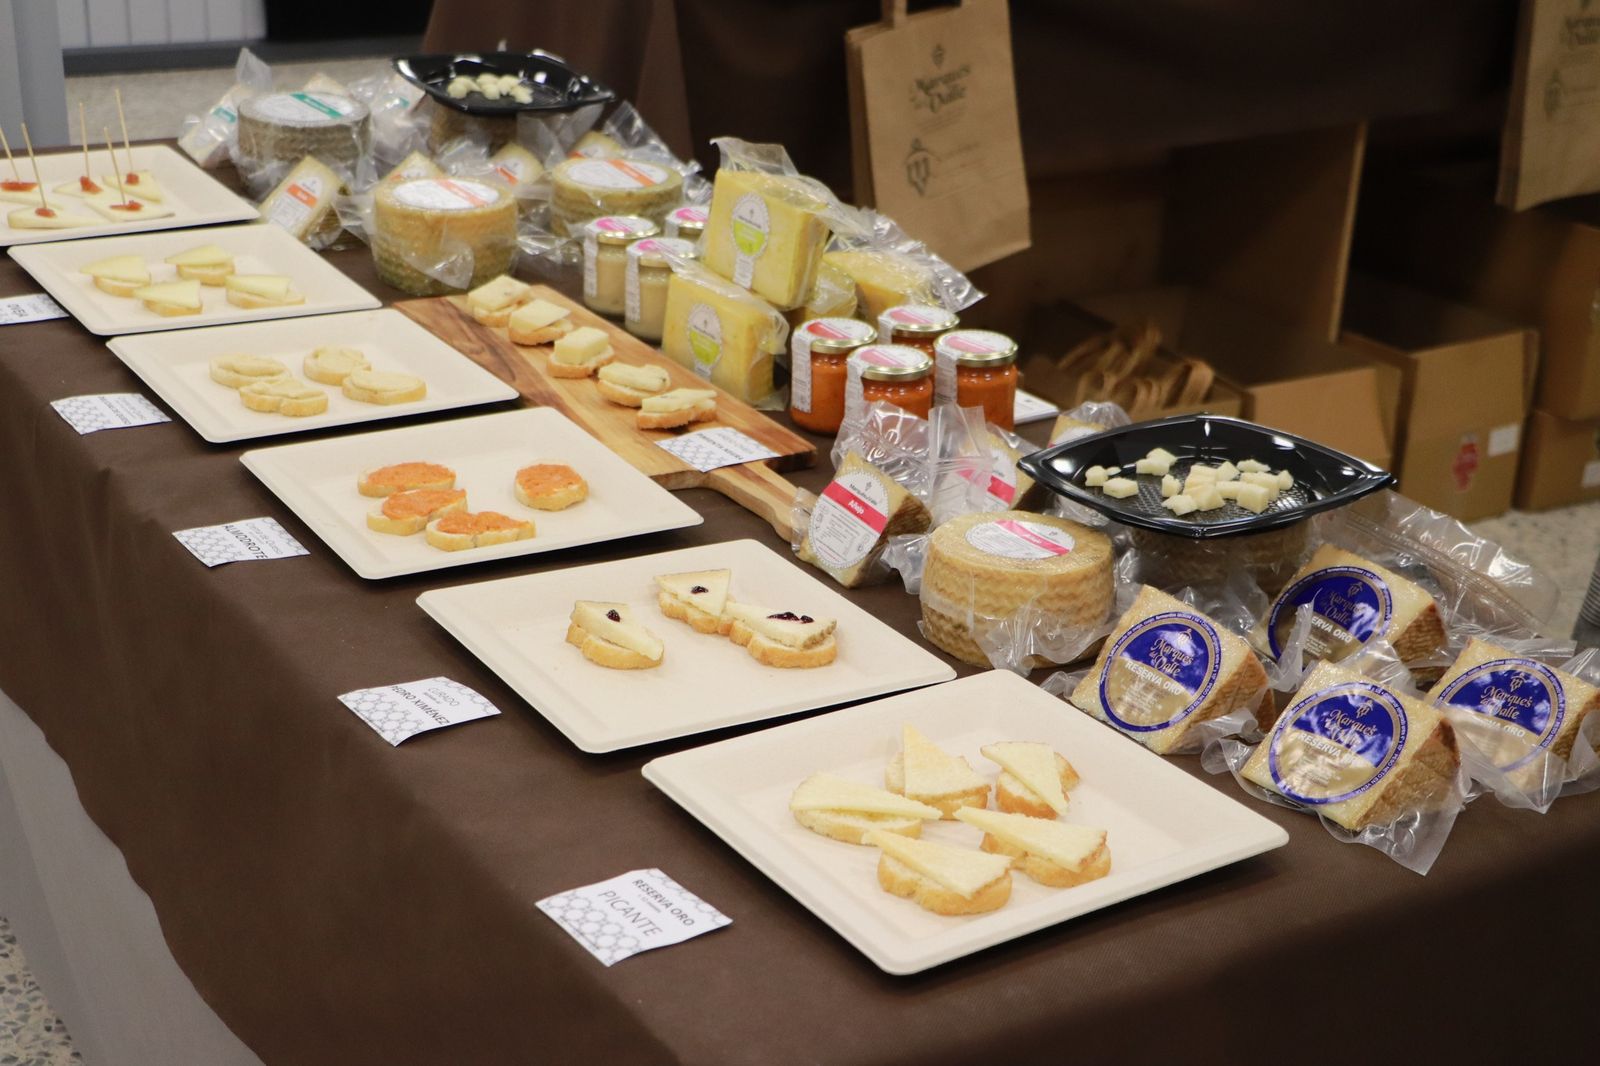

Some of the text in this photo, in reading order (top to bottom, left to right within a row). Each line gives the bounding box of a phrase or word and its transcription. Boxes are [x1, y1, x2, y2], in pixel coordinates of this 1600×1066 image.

[222, 525, 268, 559] ALMODROTE
[1311, 617, 1352, 643] ERVA ORO
[1124, 661, 1163, 686] RESERVA
[1163, 680, 1183, 696] ORO
[390, 685, 415, 702] PEDRO
[413, 698, 450, 725] XIMÉNEZ
[1489, 700, 1520, 720] Valle
[1297, 732, 1341, 758] RESERVA
[1504, 726, 1526, 738] ORO
[597, 888, 664, 938] PICANTE
[631, 879, 672, 909] RESERVA
[669, 907, 696, 927] ORO
